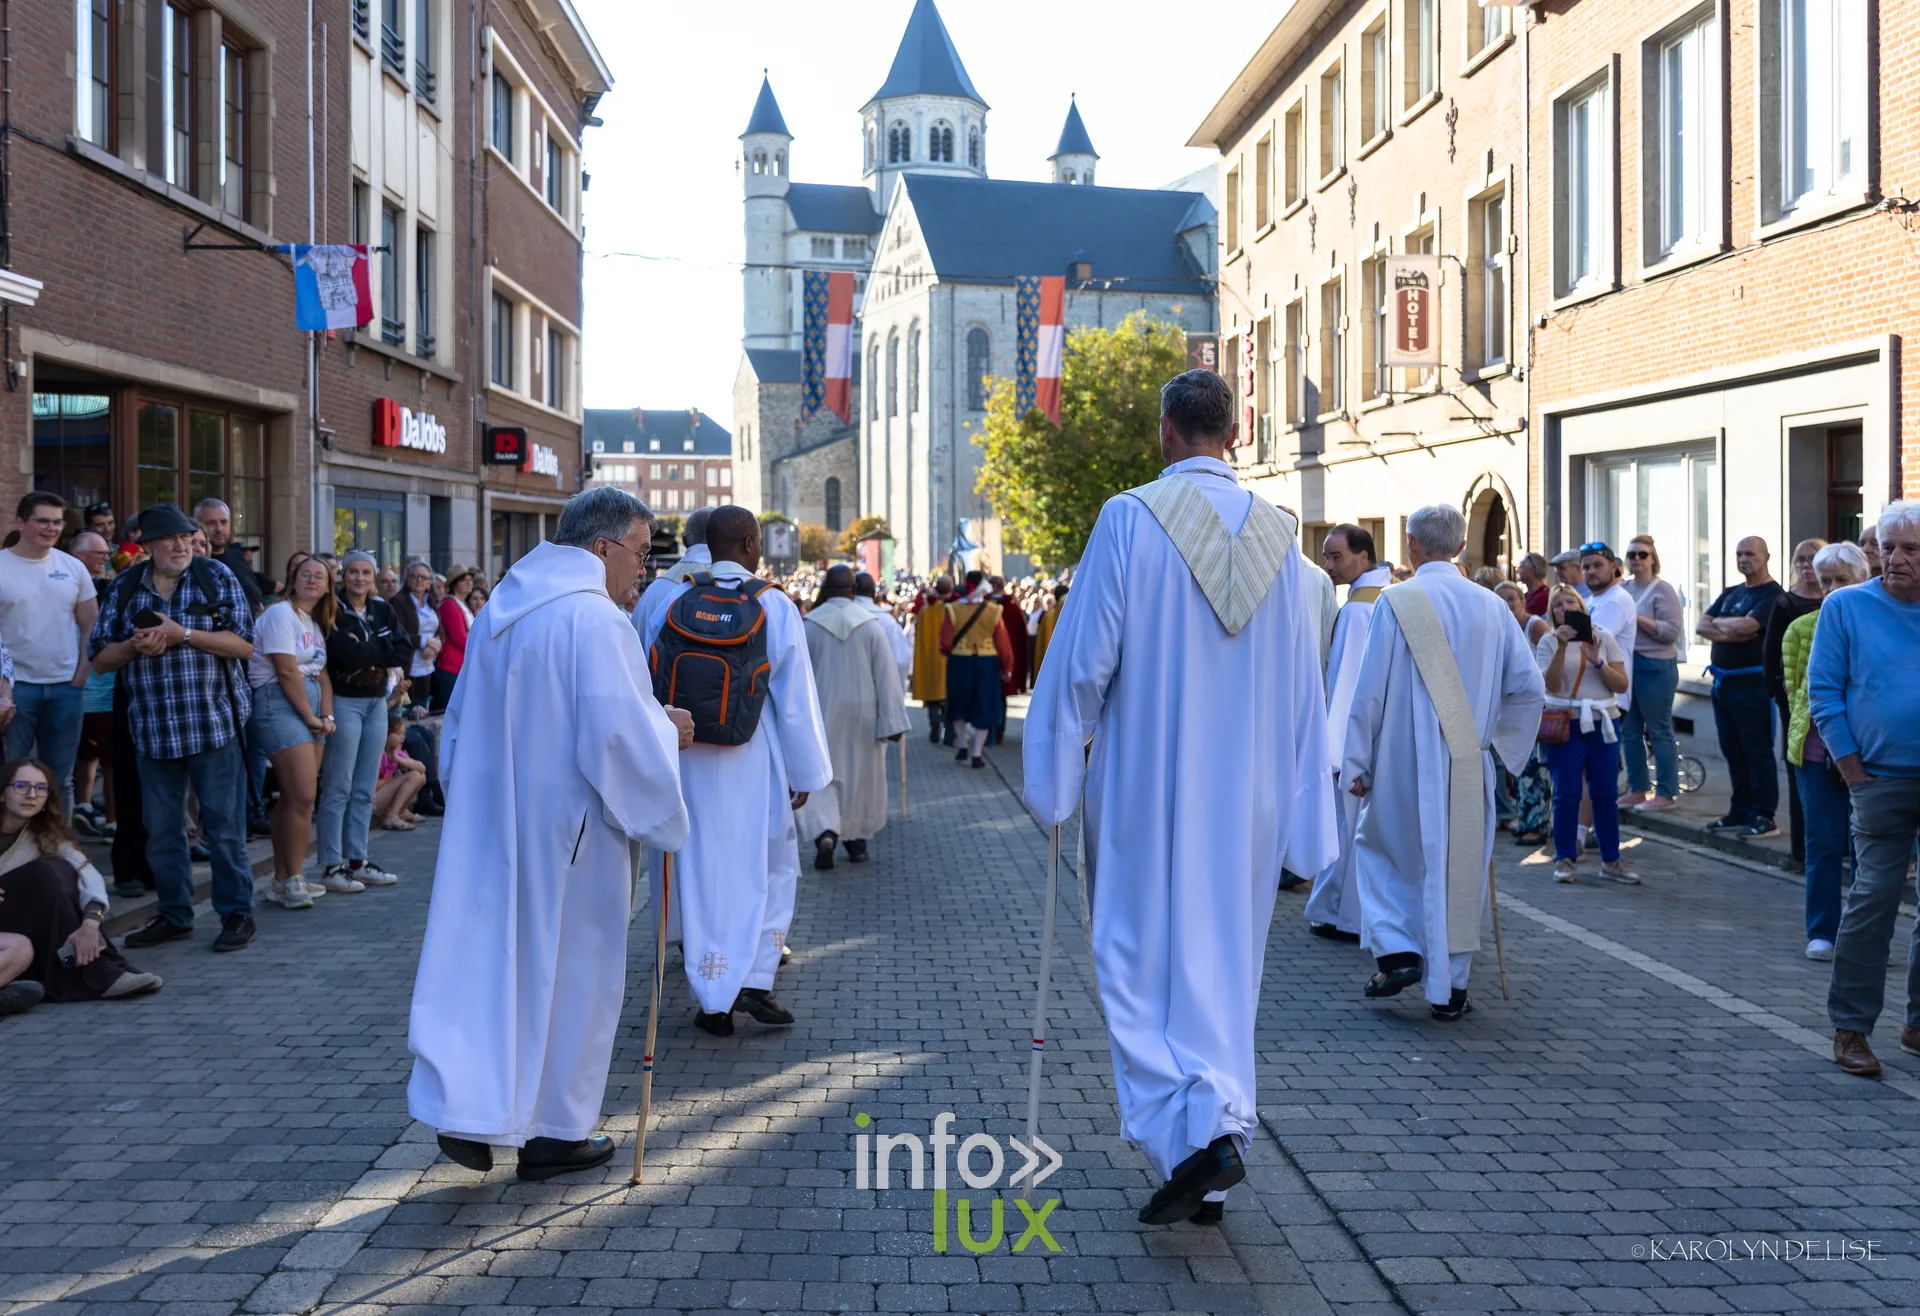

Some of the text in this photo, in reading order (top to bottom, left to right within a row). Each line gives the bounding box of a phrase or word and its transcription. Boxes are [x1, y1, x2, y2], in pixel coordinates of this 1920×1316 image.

[1407, 289, 1419, 352] HOTEL
[401, 407, 446, 454] DaJobs
[495, 452, 519, 460] DaJobs
